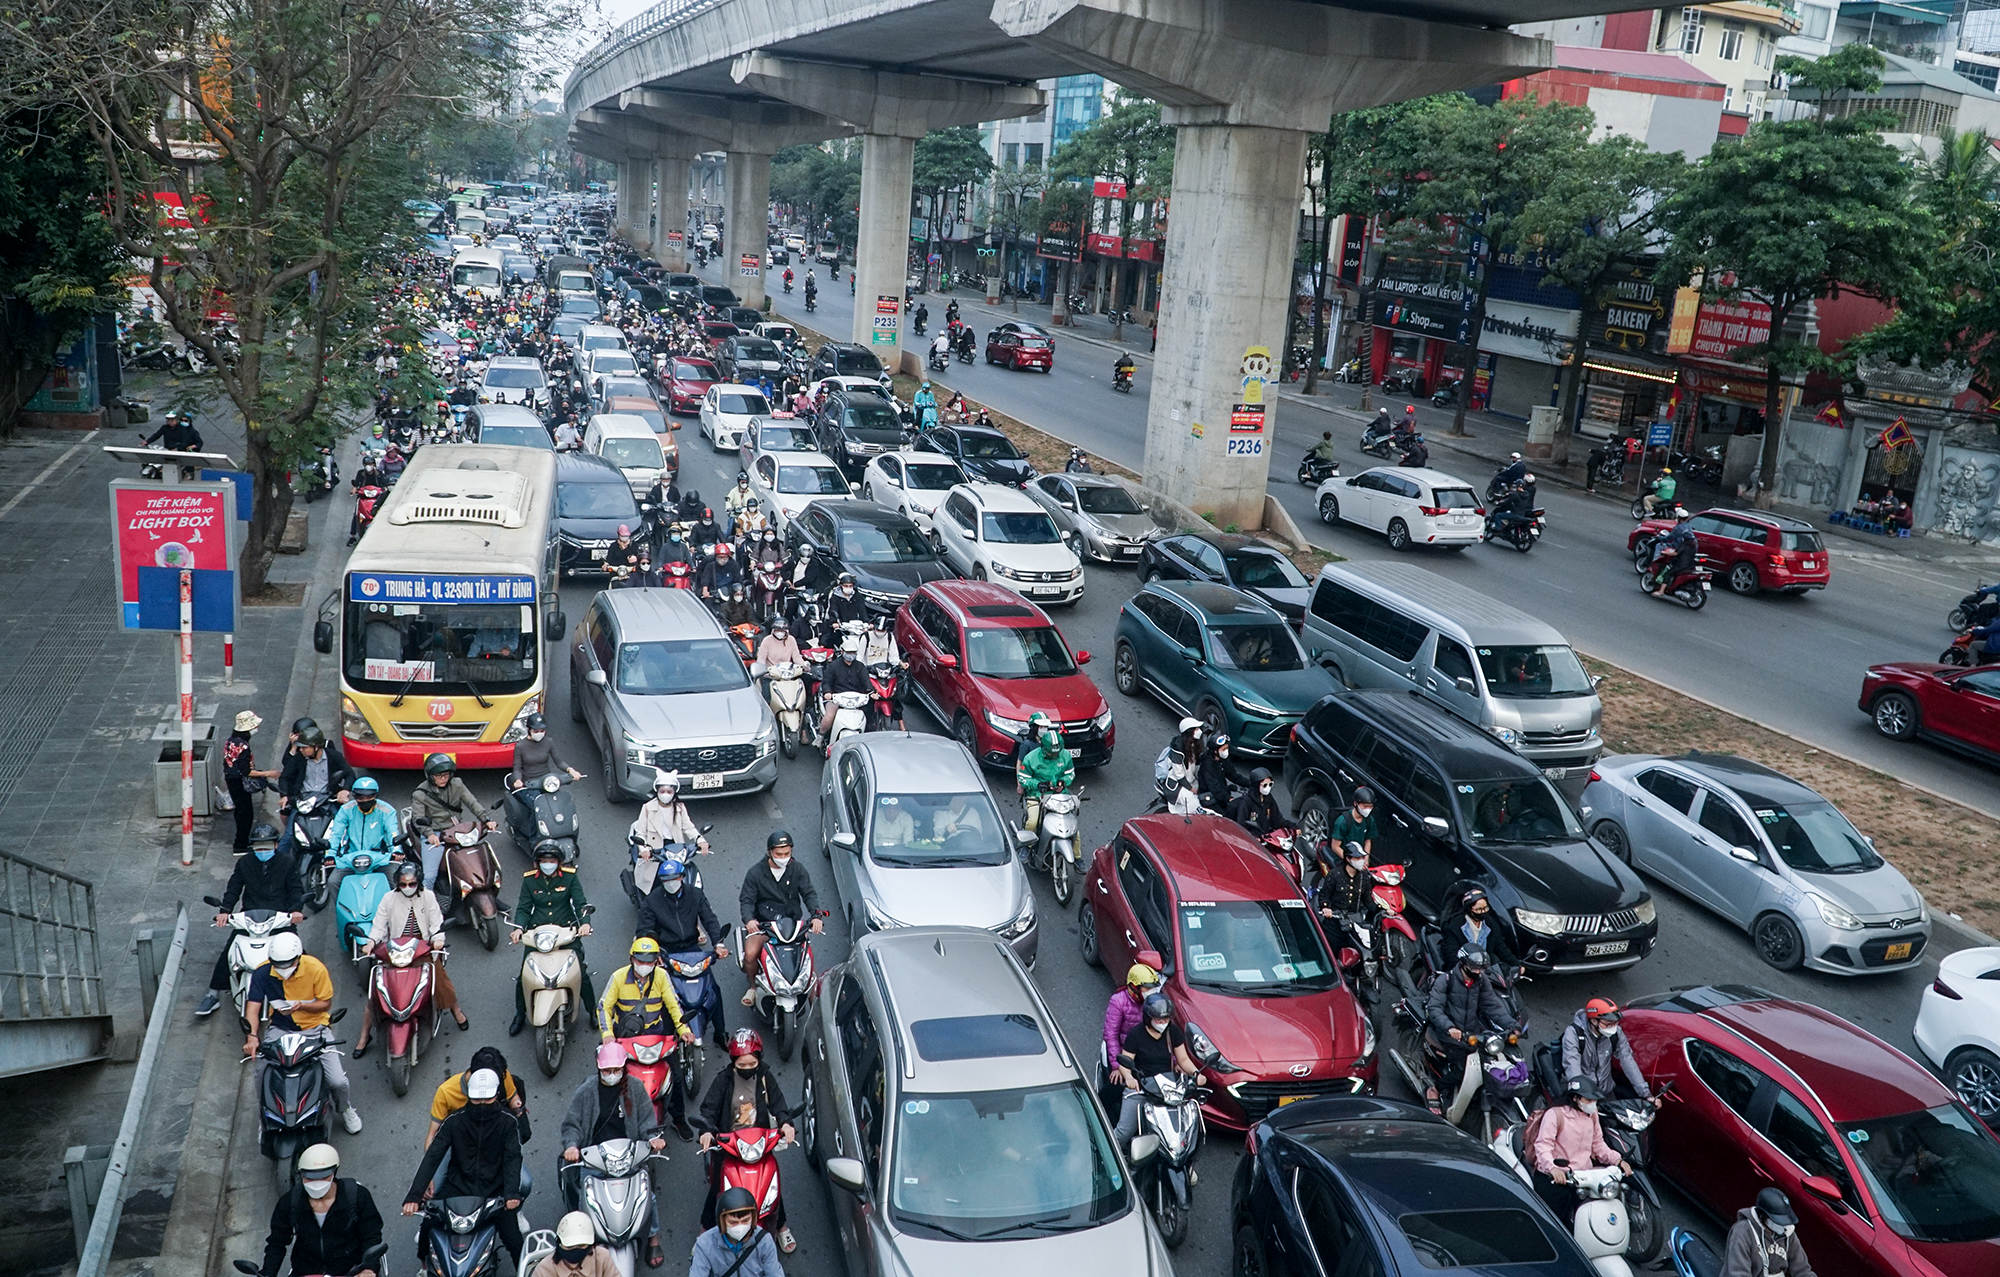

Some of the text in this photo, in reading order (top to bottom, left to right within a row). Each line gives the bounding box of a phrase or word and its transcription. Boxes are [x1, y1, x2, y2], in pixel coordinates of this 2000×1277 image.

[959, 185, 967, 225] TANNA
[1344, 259, 1359, 267] GÓP
[741, 268, 759, 276] P234
[1395, 282, 1417, 294] LAPTOP
[875, 317, 897, 327] P235
[1607, 308, 1652, 331] BAKERY
[1228, 439, 1262, 454] P236
[147, 497, 202, 509] TIẾT KIỆM
[129, 516, 214, 530] LIGHT BOX
[385, 581, 413, 598] TRUNG
[415, 578, 427, 598] HÀ
[433, 582, 443, 599] QL
[475, 579, 491, 599] TÂY
[498, 580, 510, 598] MỸ
[513, 581, 532, 599] ĐÌNH
[430, 704, 451, 716] 70A
[1199, 957, 1223, 966] Grab
